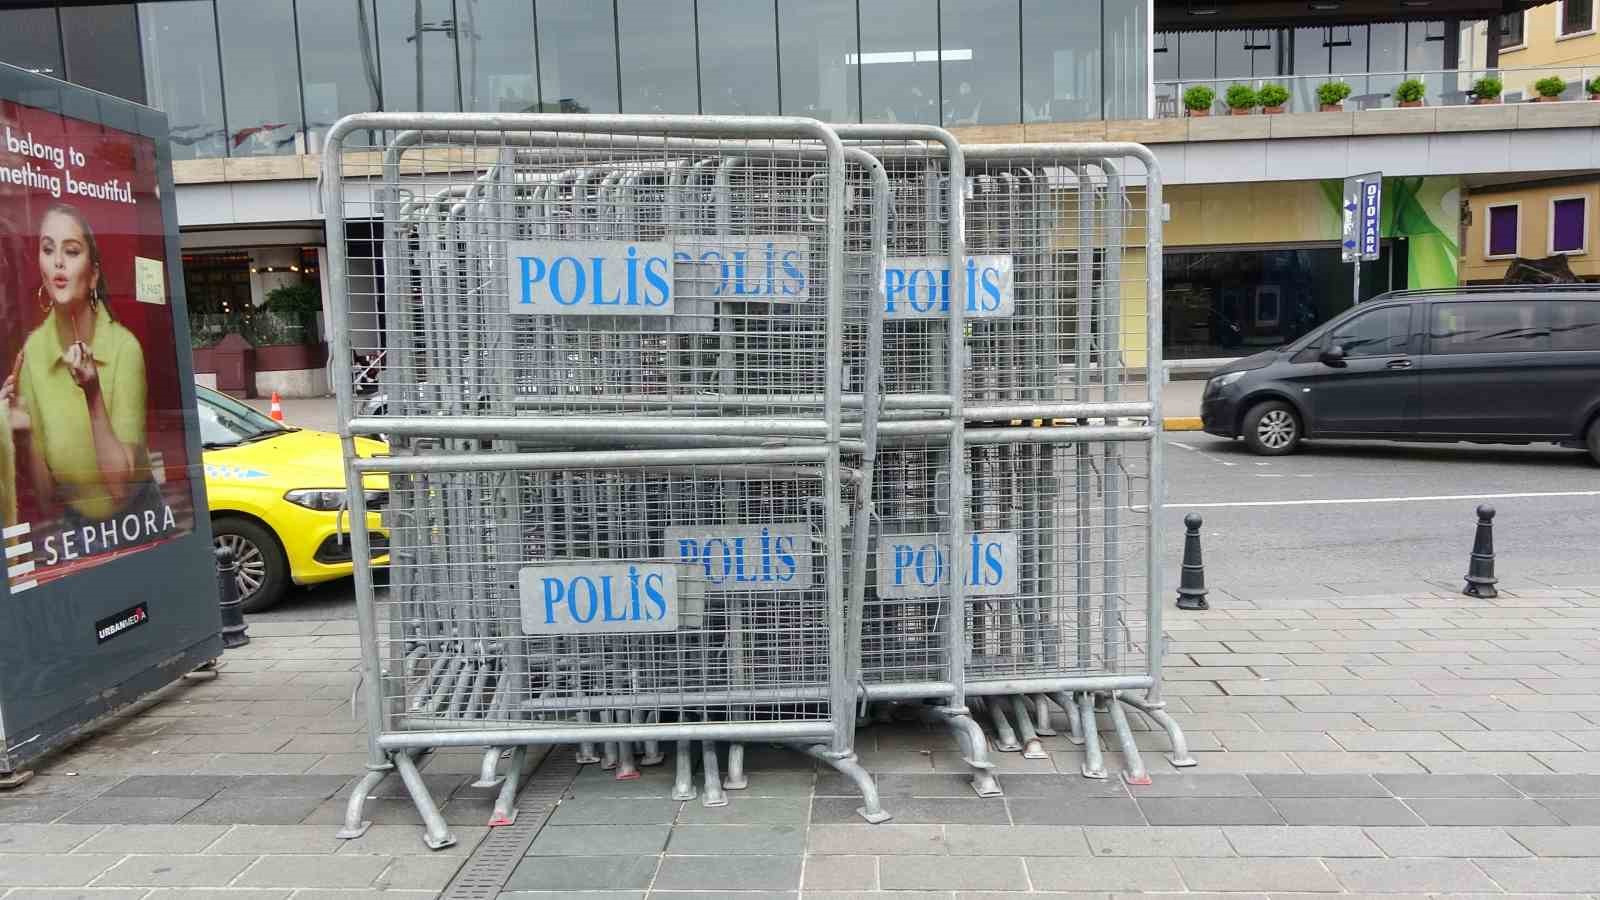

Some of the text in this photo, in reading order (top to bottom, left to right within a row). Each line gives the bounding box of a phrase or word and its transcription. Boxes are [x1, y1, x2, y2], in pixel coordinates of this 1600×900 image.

[6, 126, 86, 169] belong to
[0, 162, 136, 204] mething beautiful.
[516, 246, 670, 306] POLİS
[673, 240, 805, 296] OLİS
[44, 504, 177, 566] SEPHORA
[678, 527, 797, 585] POLİS
[893, 533, 1003, 587] POİS
[541, 565, 667, 625] POLİS
